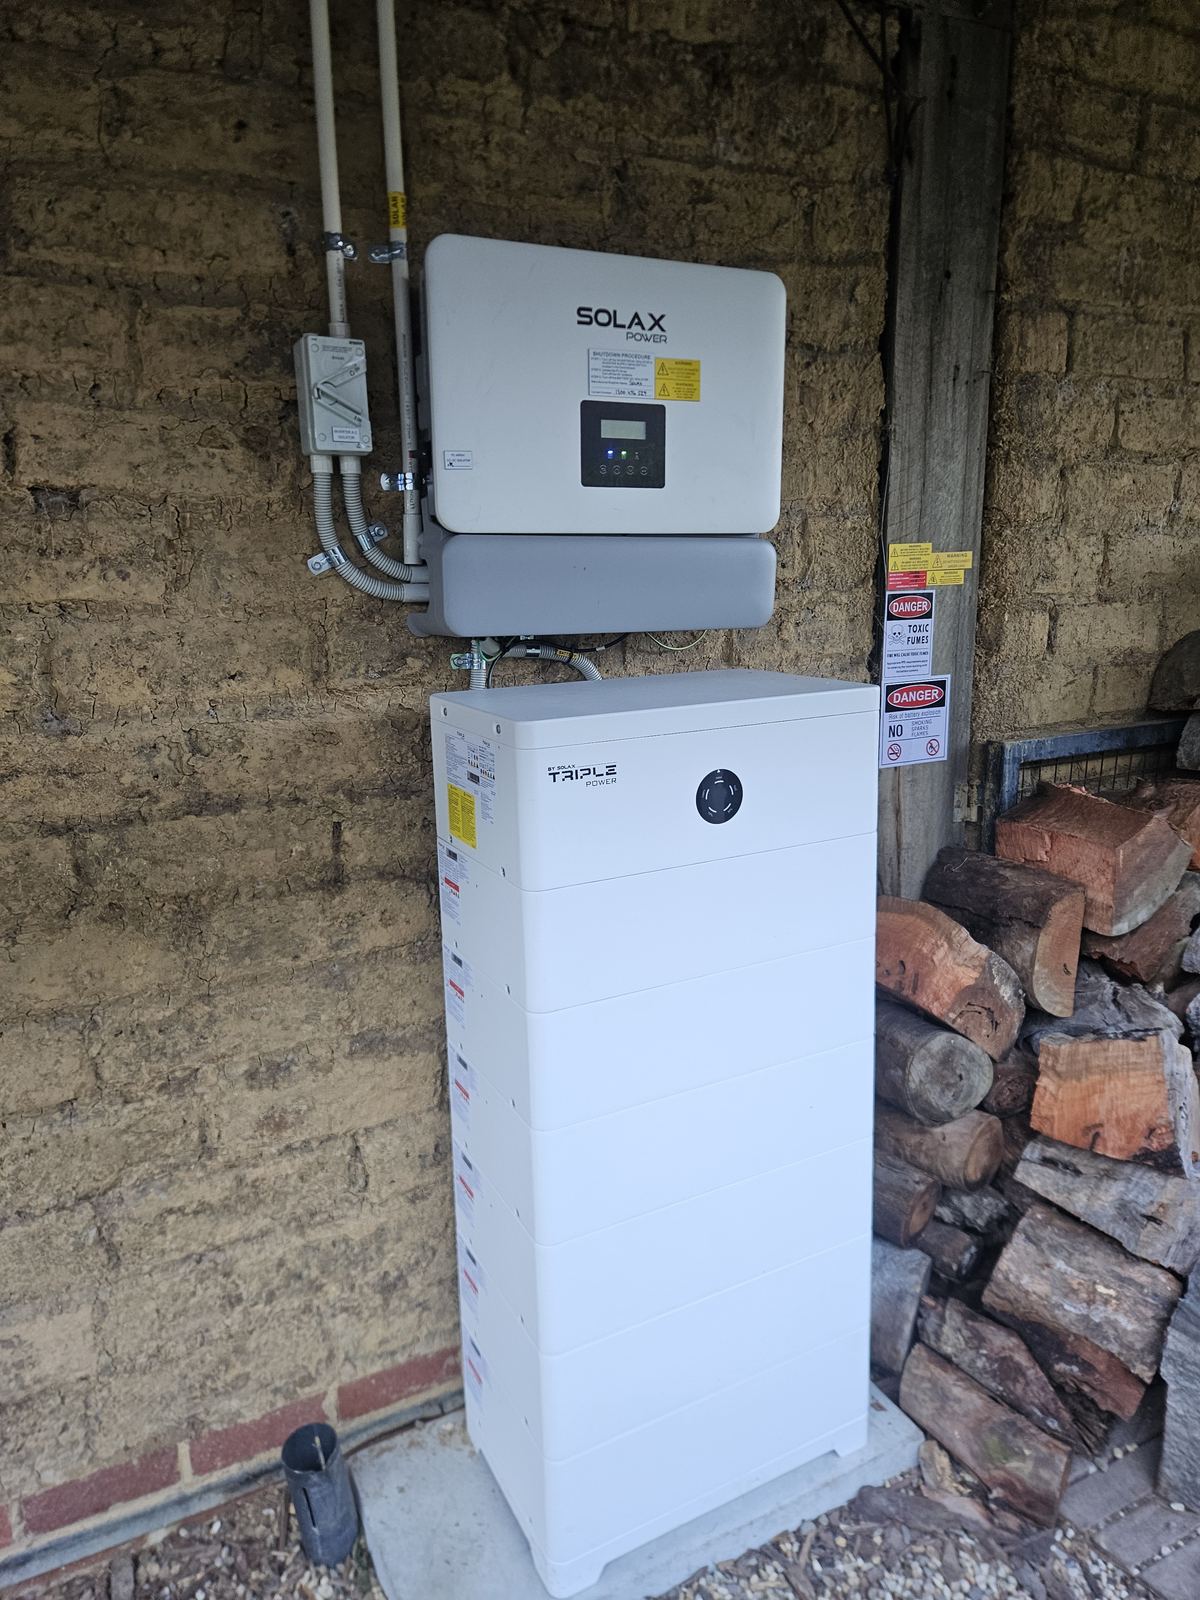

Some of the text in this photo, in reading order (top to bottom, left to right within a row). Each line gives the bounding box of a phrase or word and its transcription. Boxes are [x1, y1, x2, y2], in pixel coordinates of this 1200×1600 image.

[391, 196, 399, 225] SOLAR
[577, 306, 666, 332] SOLAX
[626, 331, 667, 343] POWER
[893, 601, 928, 613] DANGER
[908, 623, 929, 634] TOXIC
[906, 635, 929, 646] FUMES
[893, 689, 939, 704] DANGER
[888, 724, 903, 738] NO
[548, 764, 617, 783] TRIPLE
[586, 778, 617, 787] POWER
